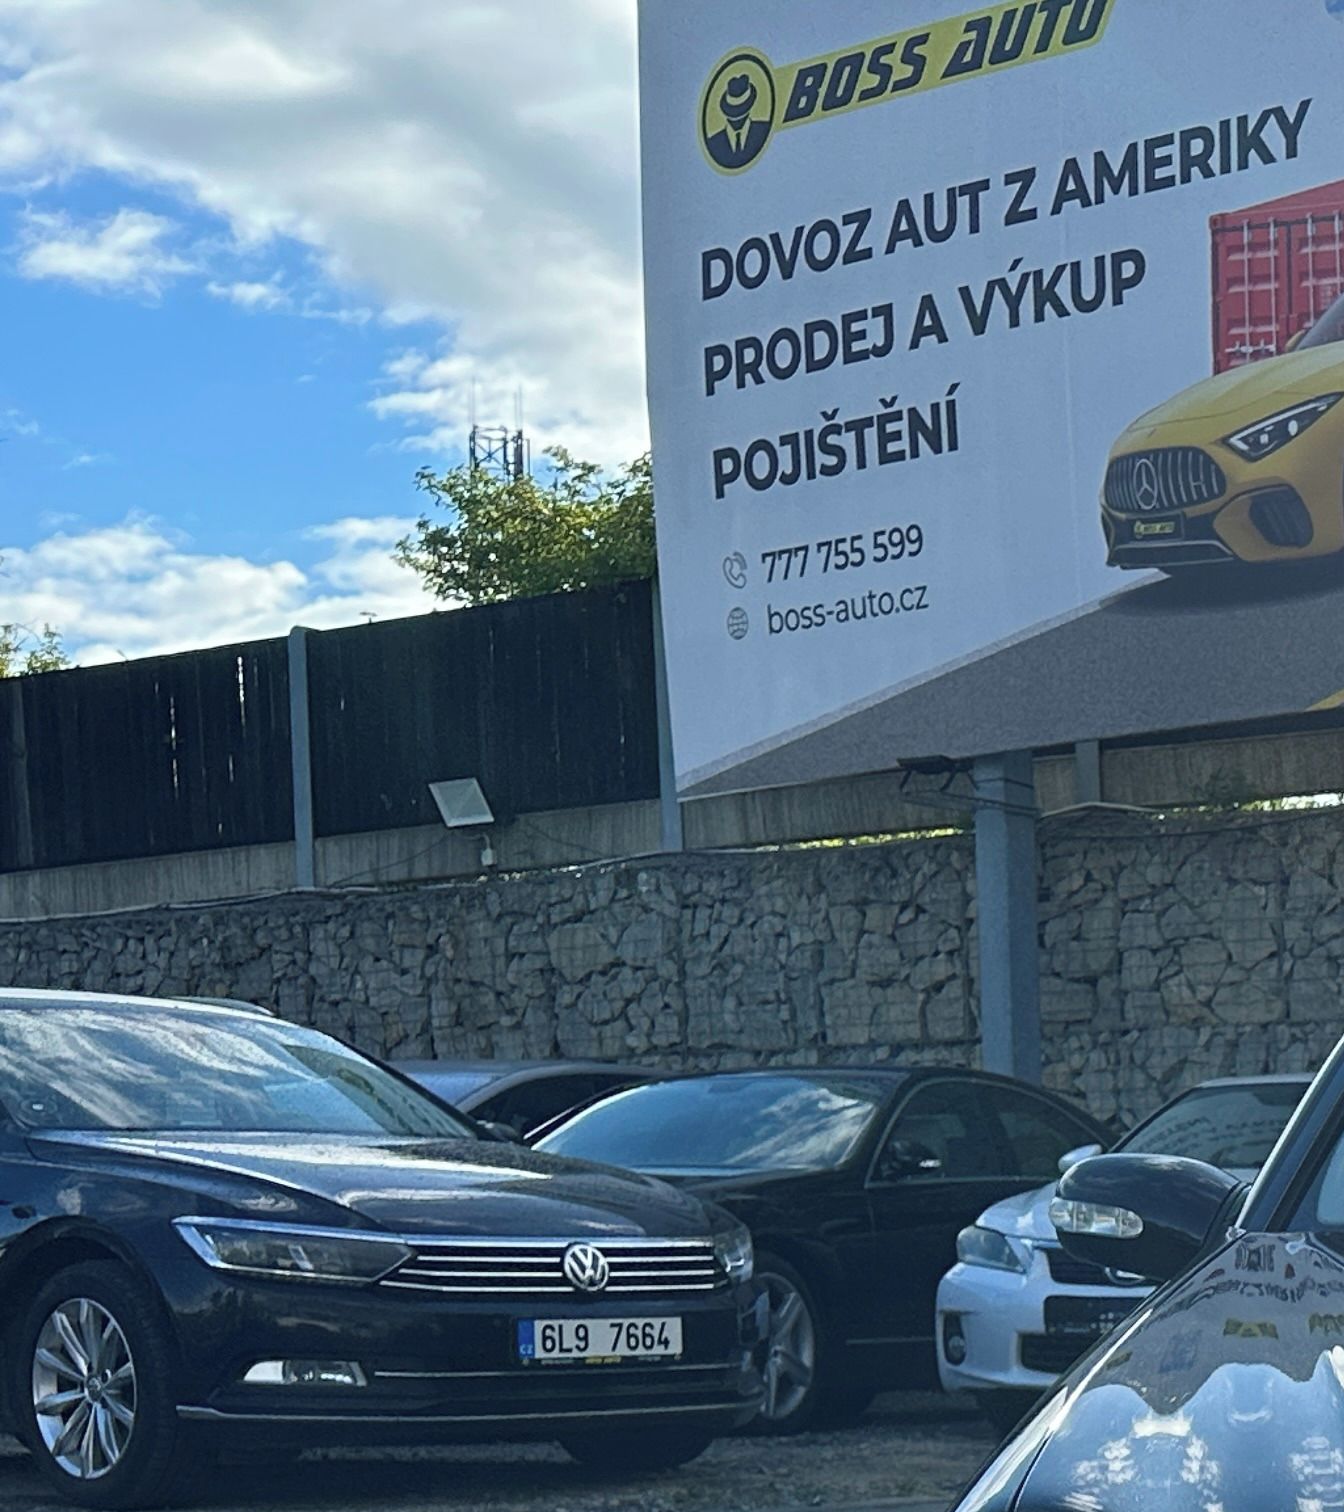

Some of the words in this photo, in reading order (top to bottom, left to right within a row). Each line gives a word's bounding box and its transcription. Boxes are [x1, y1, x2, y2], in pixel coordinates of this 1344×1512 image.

[782, 31, 931, 124] BOSS
[939, 0, 1108, 81] AUTO
[701, 207, 873, 302] DOVOZ
[884, 178, 991, 256] AUT
[1004, 166, 1038, 227] Z
[1049, 98, 1313, 217] AMERIKY
[704, 302, 895, 397] PRODEJ
[908, 293, 949, 351] A
[957, 248, 1146, 337] VÝKUP
[712, 381, 961, 500] POJIŠTĚNÍ
[760, 544, 810, 584] 777
[816, 534, 866, 574] 755
[872, 523, 924, 563] 599
[766, 585, 930, 636] boss-auto.cz
[541, 1324, 590, 1353] 6L9
[609, 1322, 671, 1352] 7664
